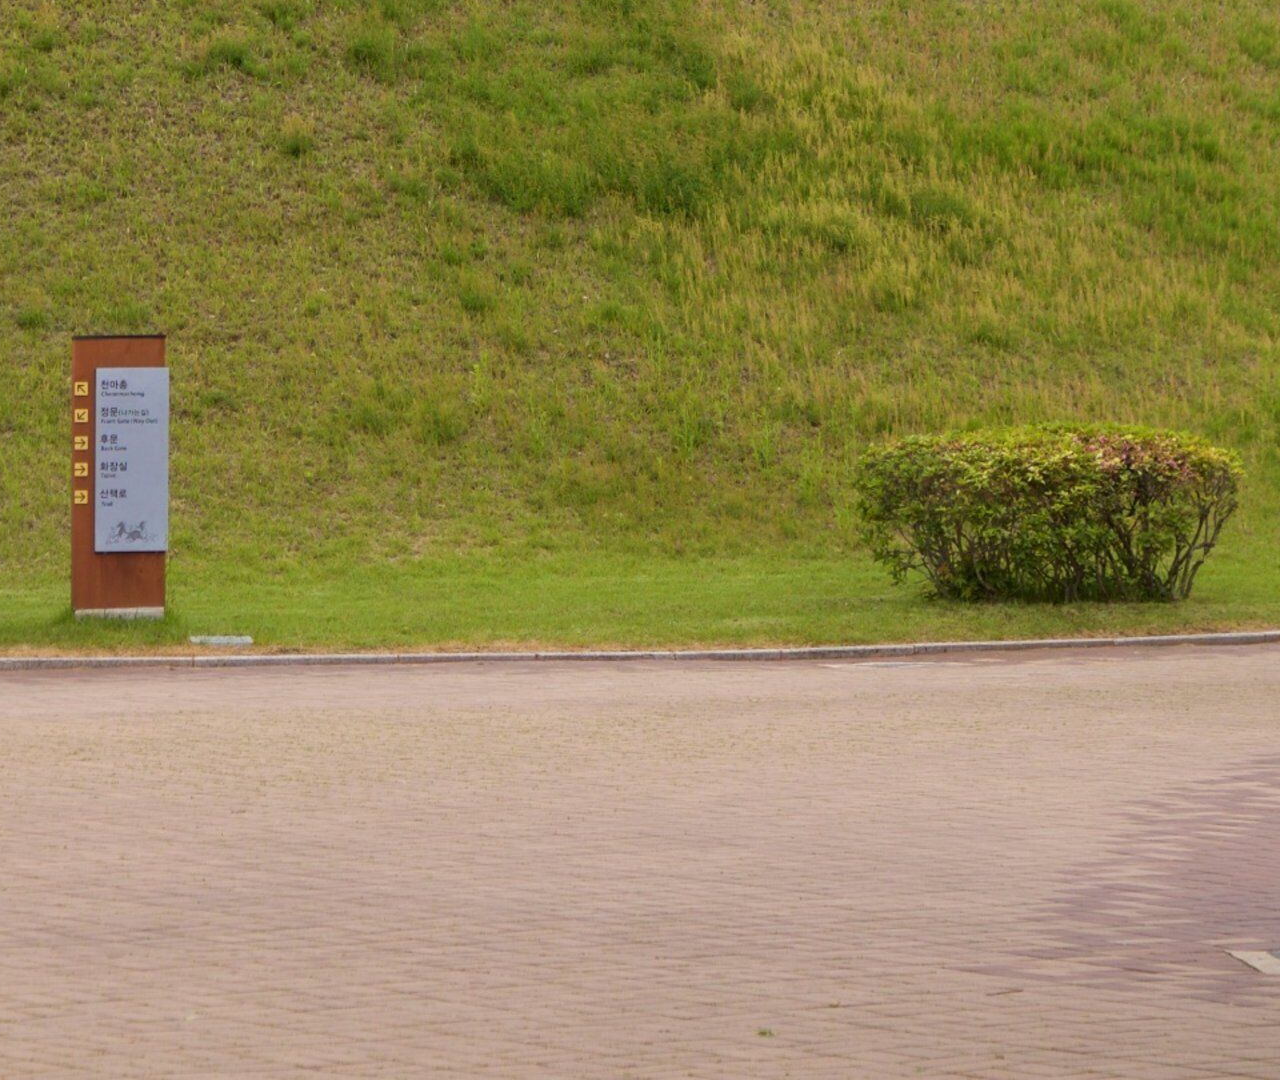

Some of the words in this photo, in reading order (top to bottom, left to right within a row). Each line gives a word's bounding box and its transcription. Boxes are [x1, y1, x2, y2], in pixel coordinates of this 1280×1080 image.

[101, 434, 118, 444] 후문
[100, 461, 127, 472] 화장실
[100, 489, 127, 499] 산책로
